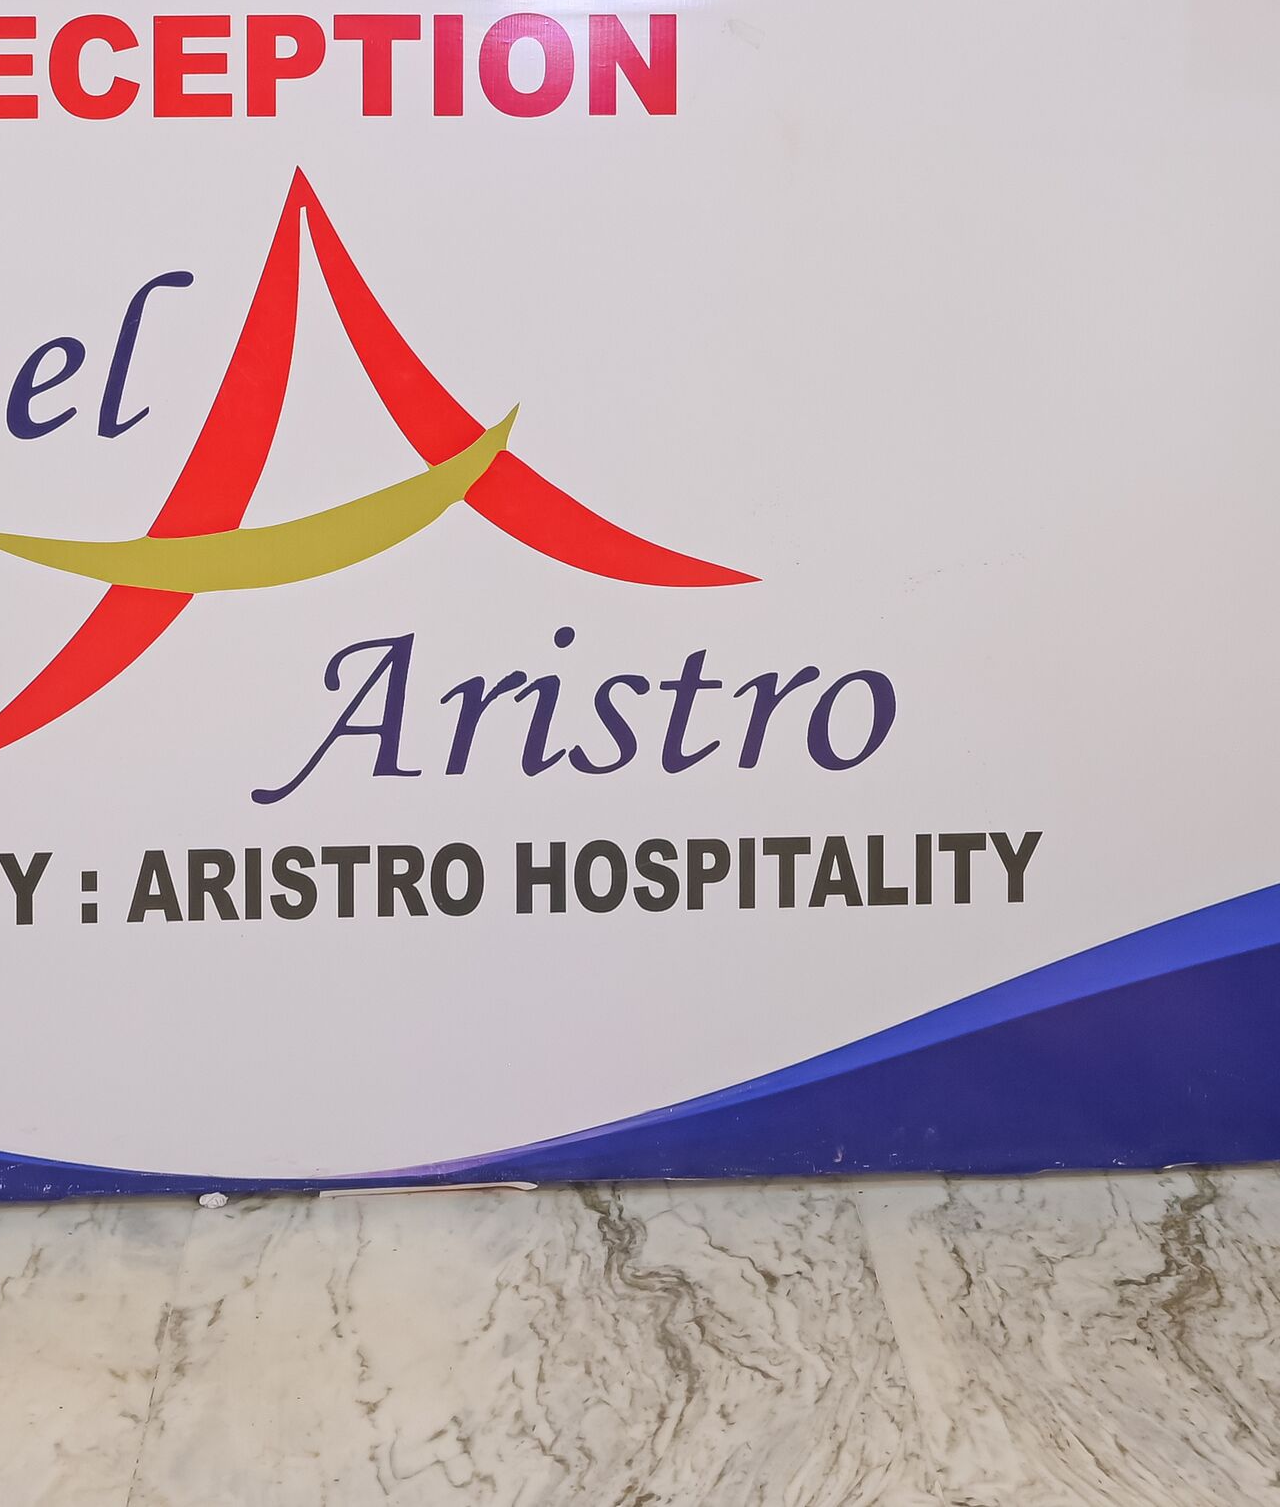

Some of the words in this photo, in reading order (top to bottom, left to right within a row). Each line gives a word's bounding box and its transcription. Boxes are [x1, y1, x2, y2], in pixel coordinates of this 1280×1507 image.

[250, 626, 897, 805] Aristro
[126, 842, 485, 923] ARISTRO
[515, 831, 1044, 915] HOSPITALITY
